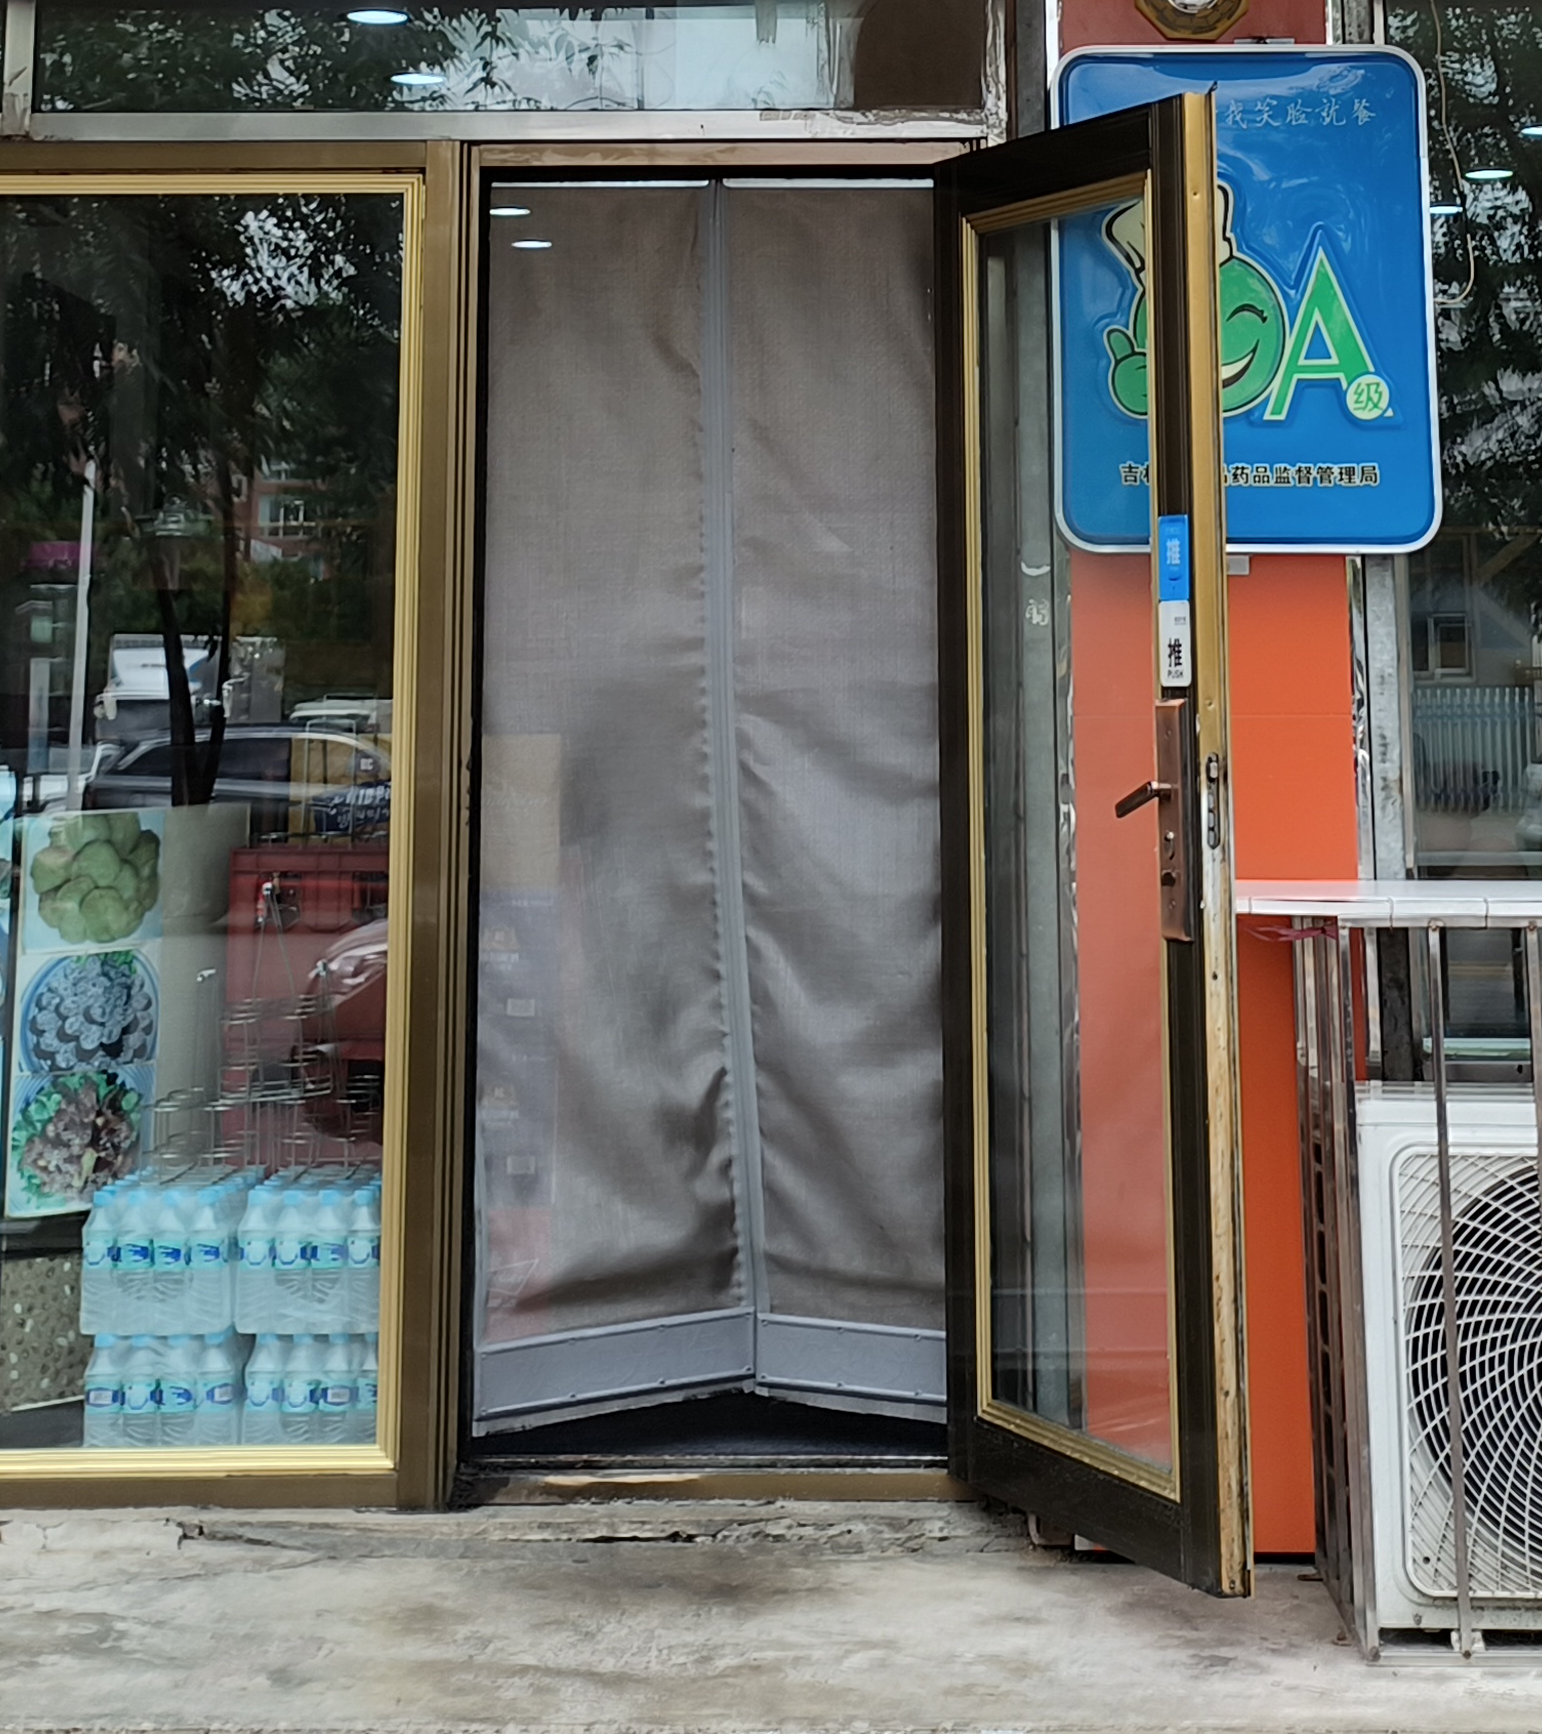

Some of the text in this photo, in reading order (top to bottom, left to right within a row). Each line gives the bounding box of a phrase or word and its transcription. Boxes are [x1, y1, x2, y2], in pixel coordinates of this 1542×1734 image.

[1216, 98, 1377, 129] 找笑脸就餐
[1120, 462, 1380, 487] 吉药品监督管理局
[1167, 637, 1183, 668] 推
